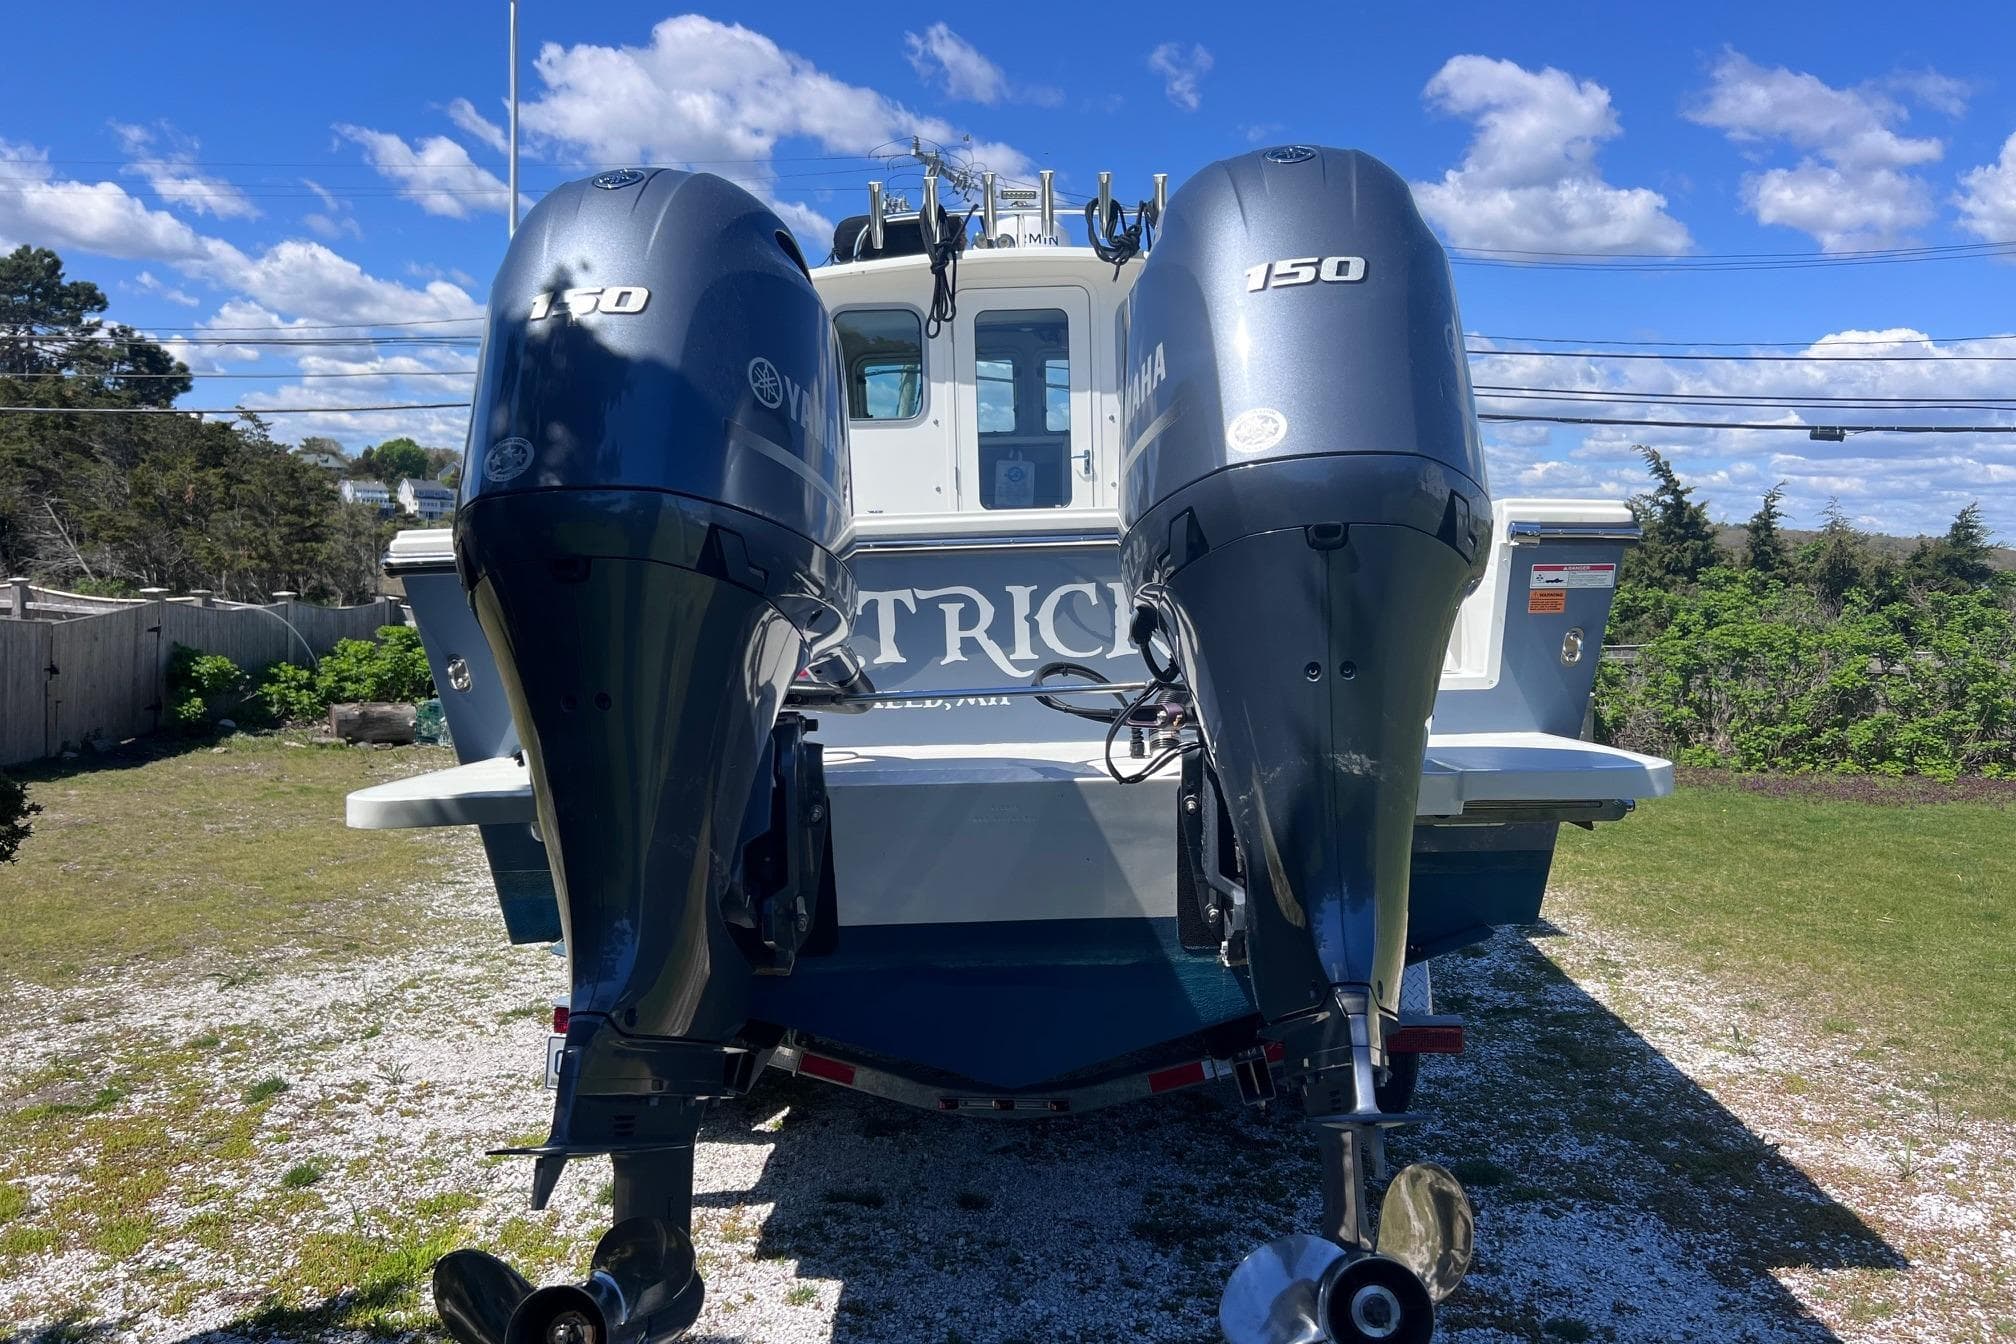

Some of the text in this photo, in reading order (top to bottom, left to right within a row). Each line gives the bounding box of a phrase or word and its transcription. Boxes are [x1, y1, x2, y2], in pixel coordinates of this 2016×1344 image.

[1024, 233, 1059, 246] MIN
[1244, 256, 1368, 293] 150
[529, 286, 651, 321] 150
